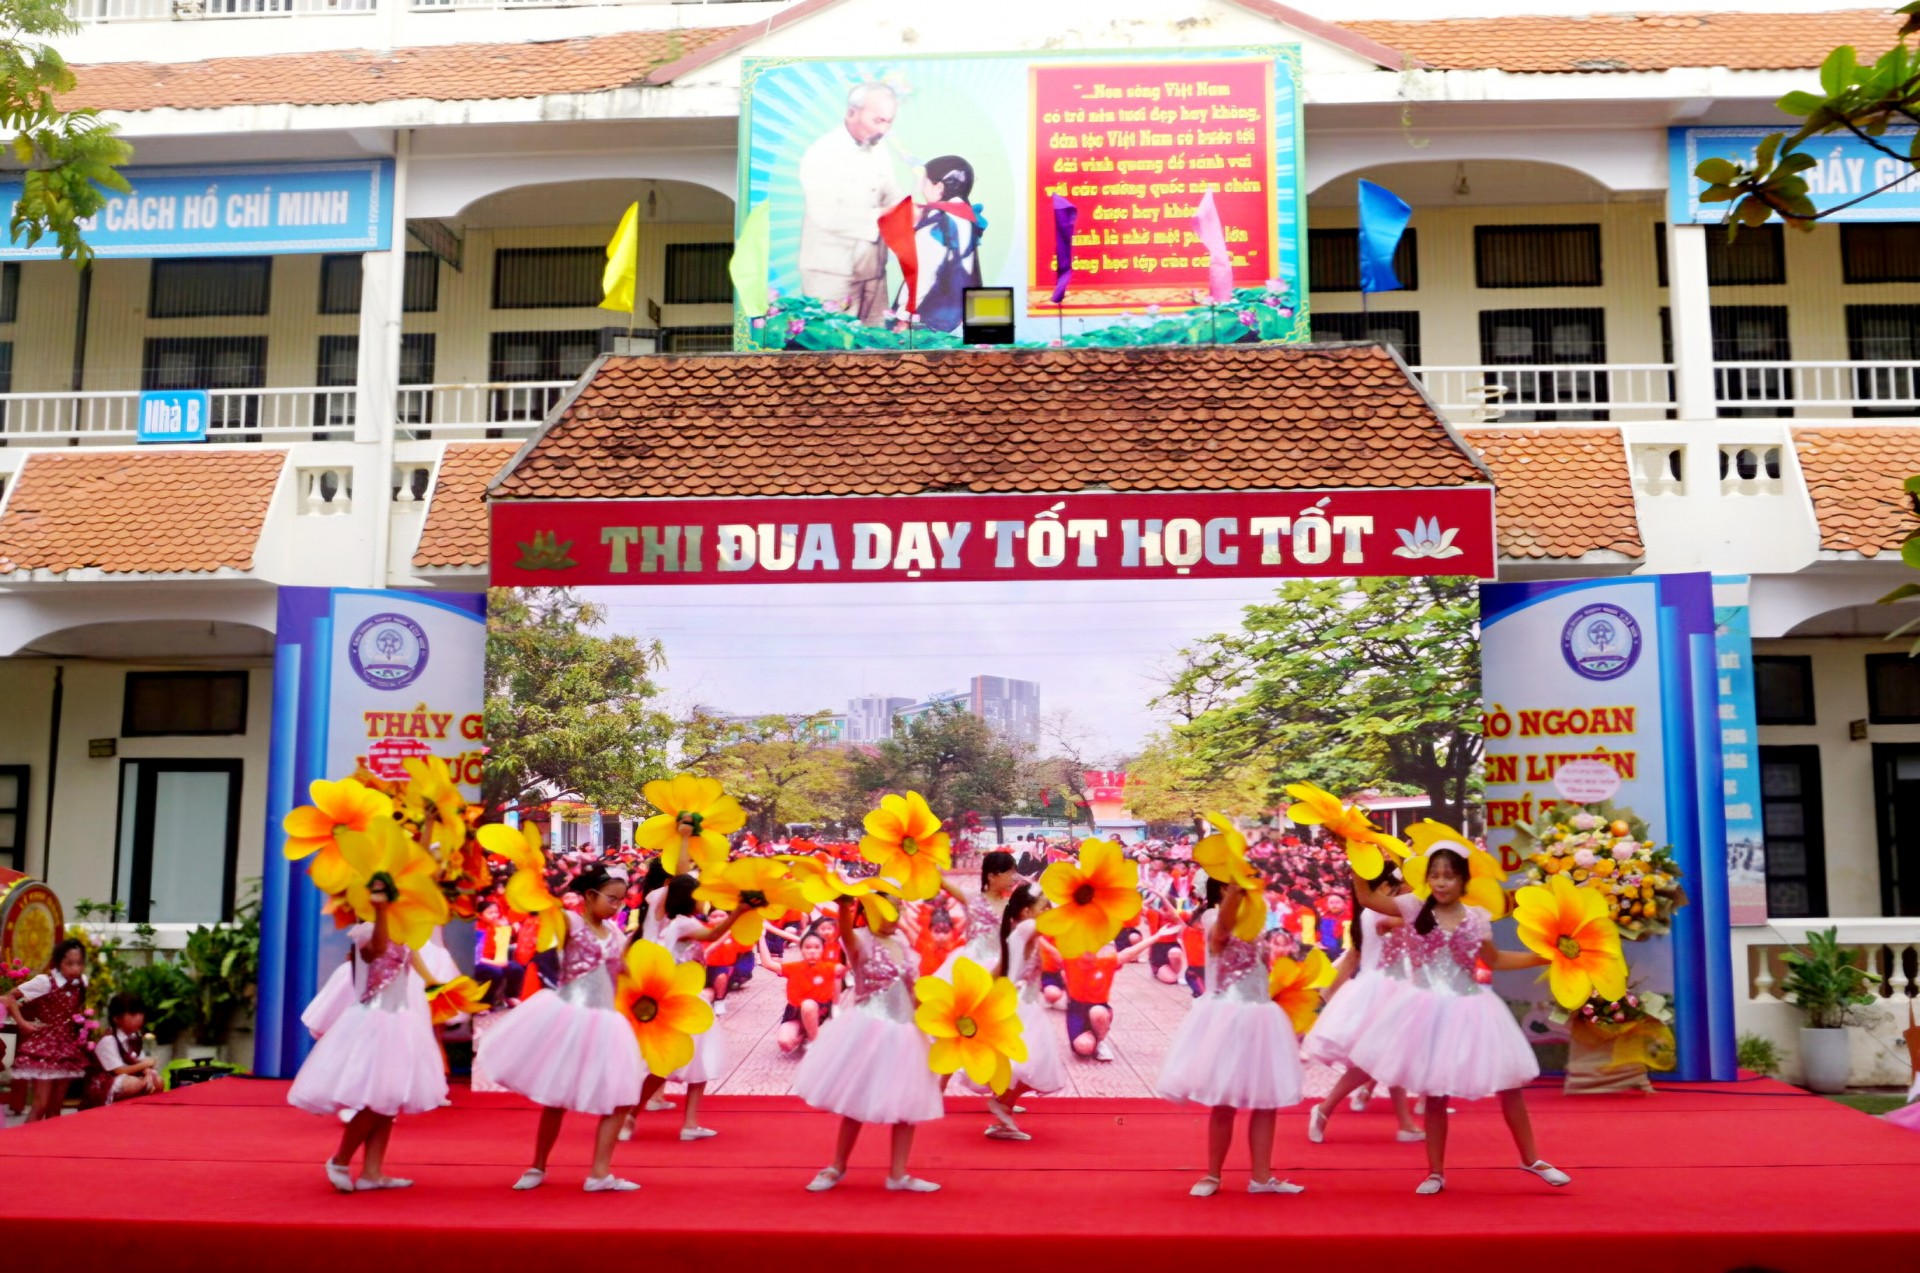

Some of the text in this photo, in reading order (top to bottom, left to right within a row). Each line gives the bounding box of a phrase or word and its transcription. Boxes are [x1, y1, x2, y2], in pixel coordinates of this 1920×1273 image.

[1164, 82, 1193, 99] Việt
[1196, 81, 1231, 96] Nam
[1043, 109, 1061, 123] có
[1150, 106, 1177, 124] đẹp
[1180, 105, 1208, 124] hay
[1107, 130, 1136, 150] Việt
[1139, 129, 1173, 146] Nam
[1177, 128, 1194, 146] có
[1081, 157, 1114, 171] vinh
[1117, 159, 1163, 174] quang
[1804, 147, 1865, 194] HẦY
[106, 189, 176, 231] CÁCH
[225, 185, 271, 228] CHÍ
[277, 190, 348, 227] MINH
[1132, 203, 1160, 222] hay
[1163, 203, 1199, 218] khôn
[1071, 255, 1099, 274] ông
[1191, 252, 1210, 268] cá
[186, 398, 200, 433] B
[600, 496, 1374, 577] THI ĐUA DẠY TỐT HỌC TỐT
[364, 702, 453, 738] THẦY
[1518, 707, 1636, 736] NGOAN
